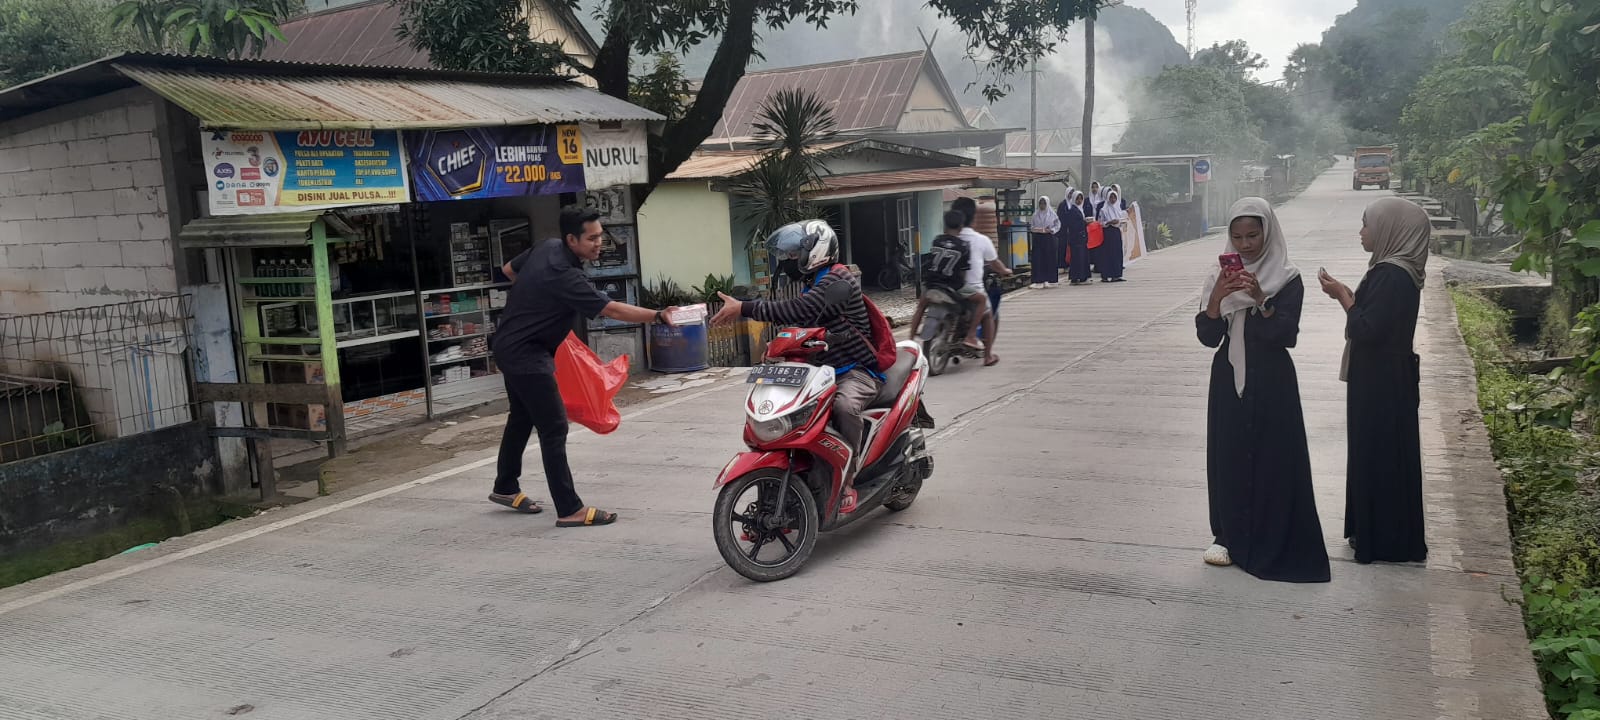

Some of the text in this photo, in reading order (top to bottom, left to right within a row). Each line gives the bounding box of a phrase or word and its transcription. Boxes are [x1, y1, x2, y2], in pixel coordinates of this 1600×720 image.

[333, 129, 375, 148] CELL
[561, 128, 577, 137] NEW
[494, 145, 527, 163] LEBIH
[562, 138, 578, 154] 16
[437, 143, 476, 176] CHIEF
[586, 147, 639, 168] NURUL
[504, 164, 546, 183] 22.000
[297, 192, 326, 202] DISINI
[328, 191, 350, 201] JUAL
[928, 246, 962, 276] 77
[751, 366, 763, 374] DD
[794, 368, 807, 376] EY
